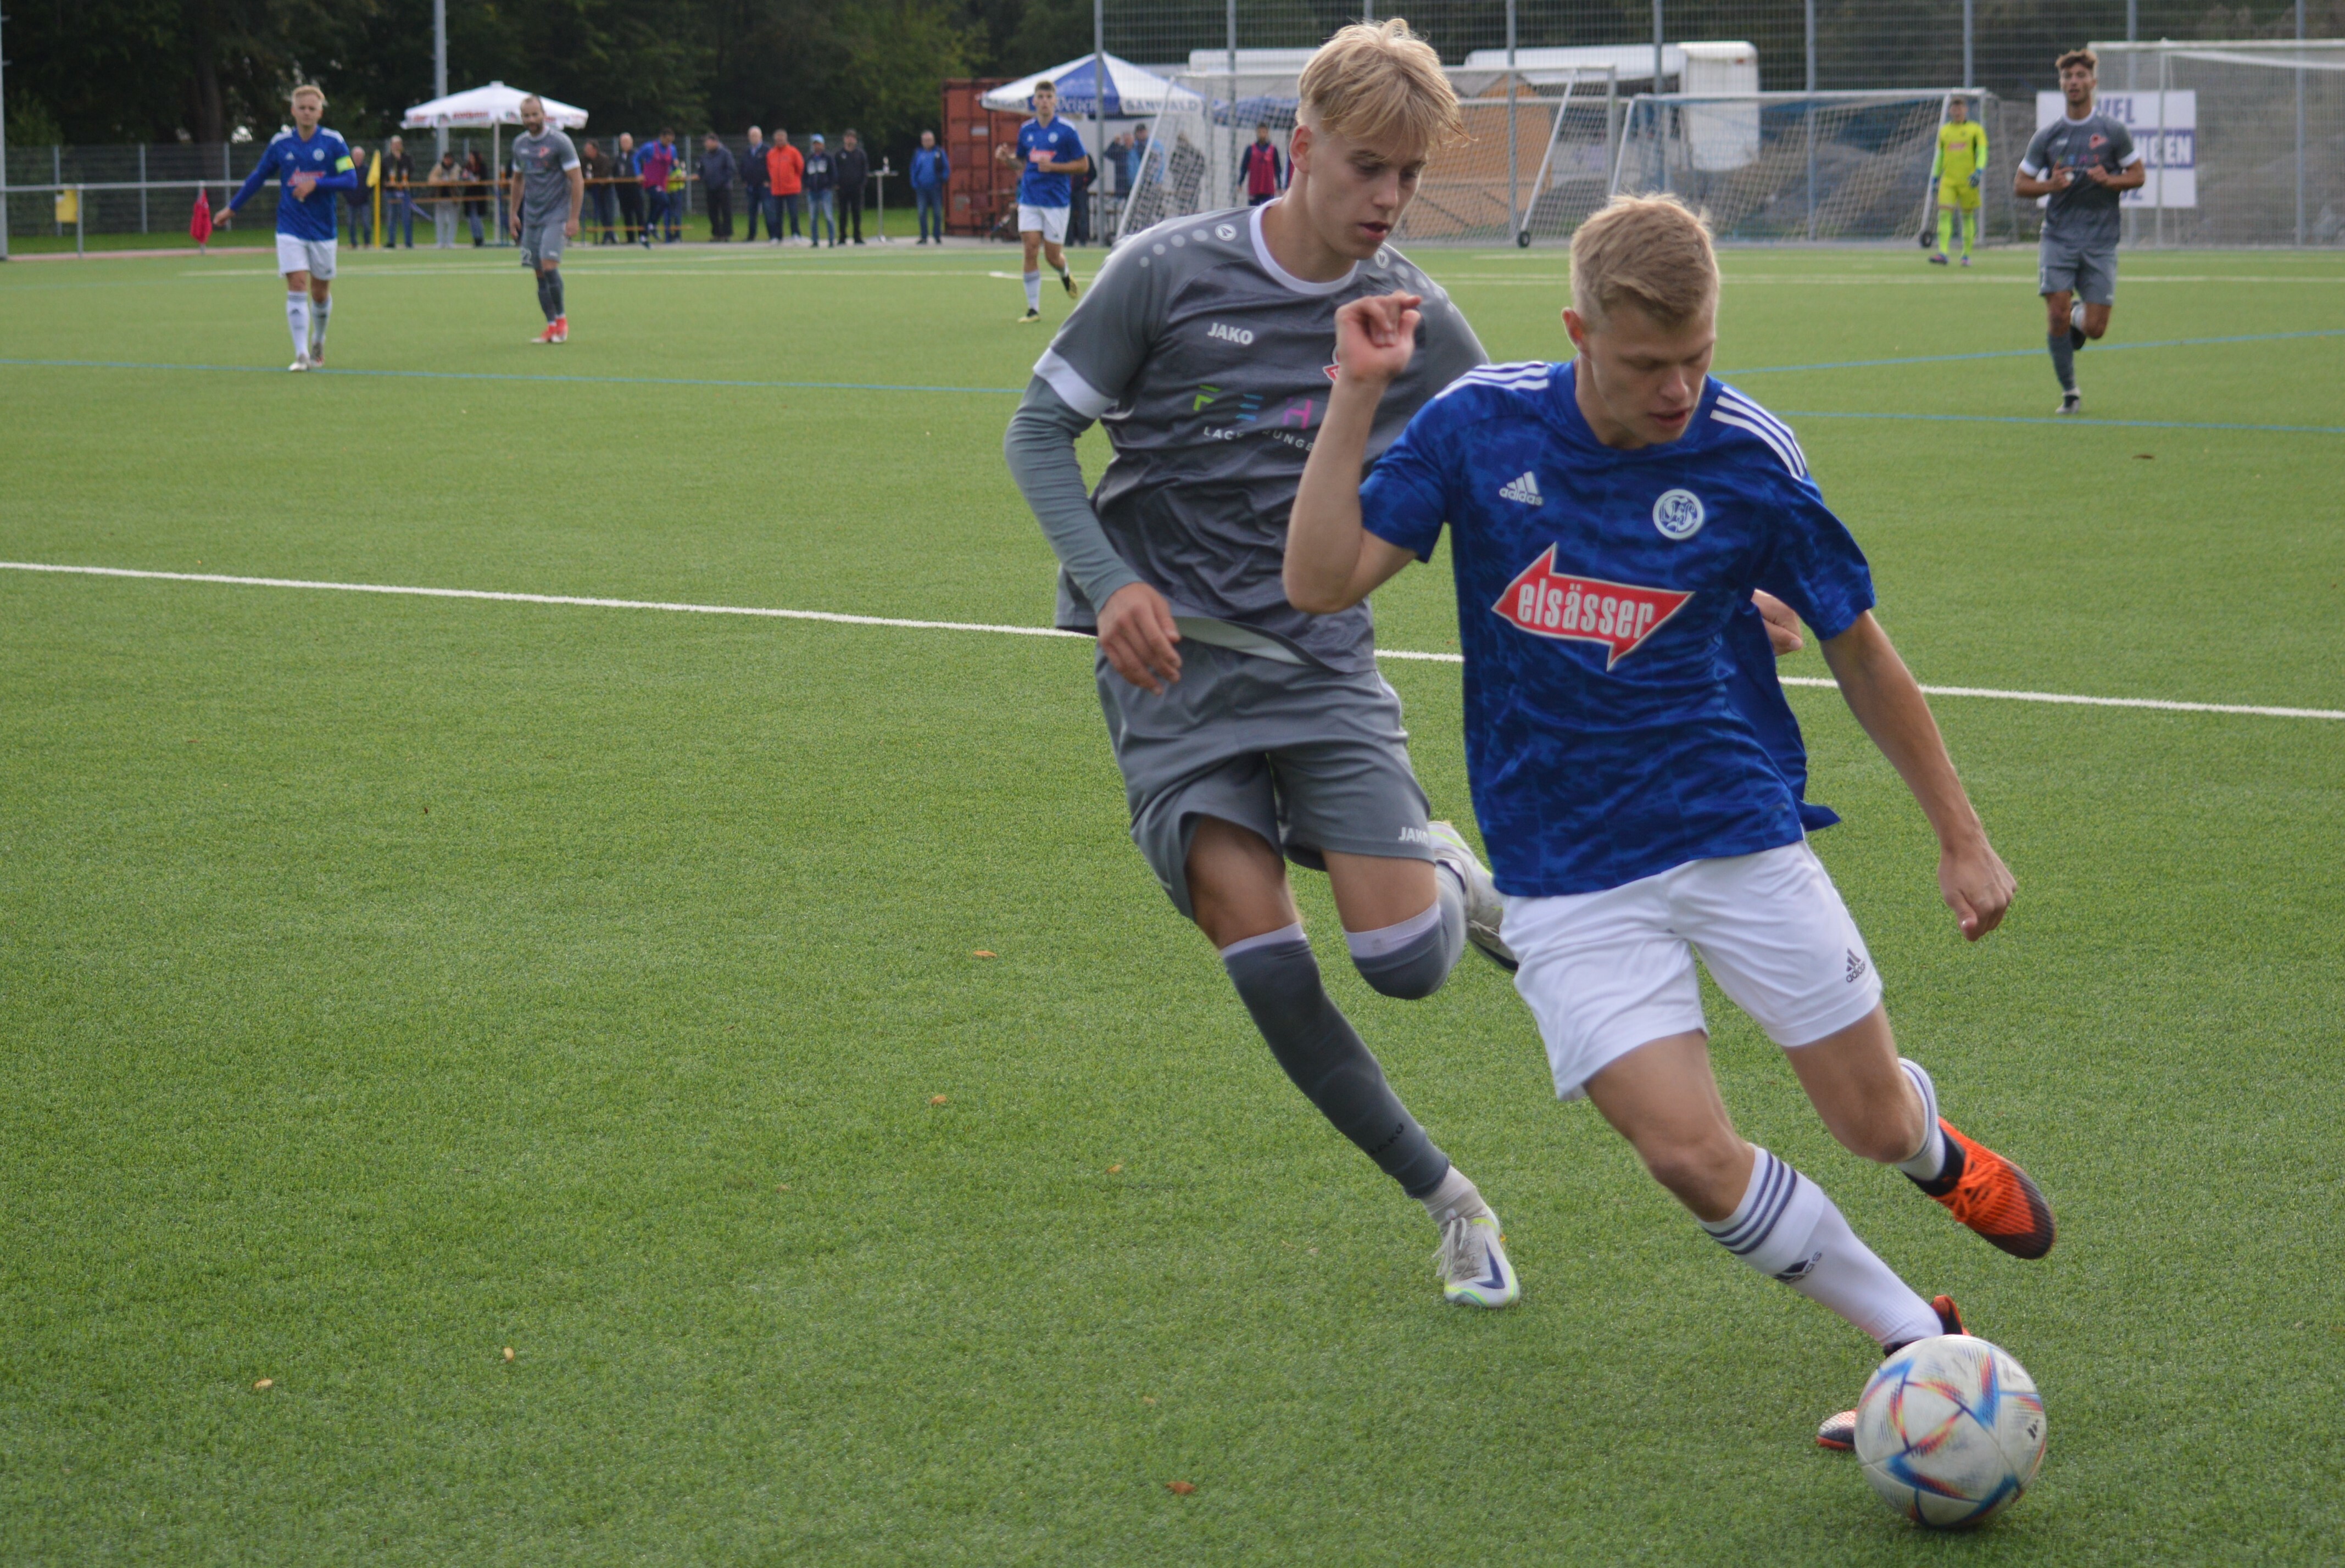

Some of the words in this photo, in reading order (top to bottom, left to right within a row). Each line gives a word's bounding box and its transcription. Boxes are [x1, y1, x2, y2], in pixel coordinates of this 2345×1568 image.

[1207, 322, 1254, 345] JAKO
[1499, 487, 1543, 506] adidas
[1517, 578, 1654, 639] elsässer
